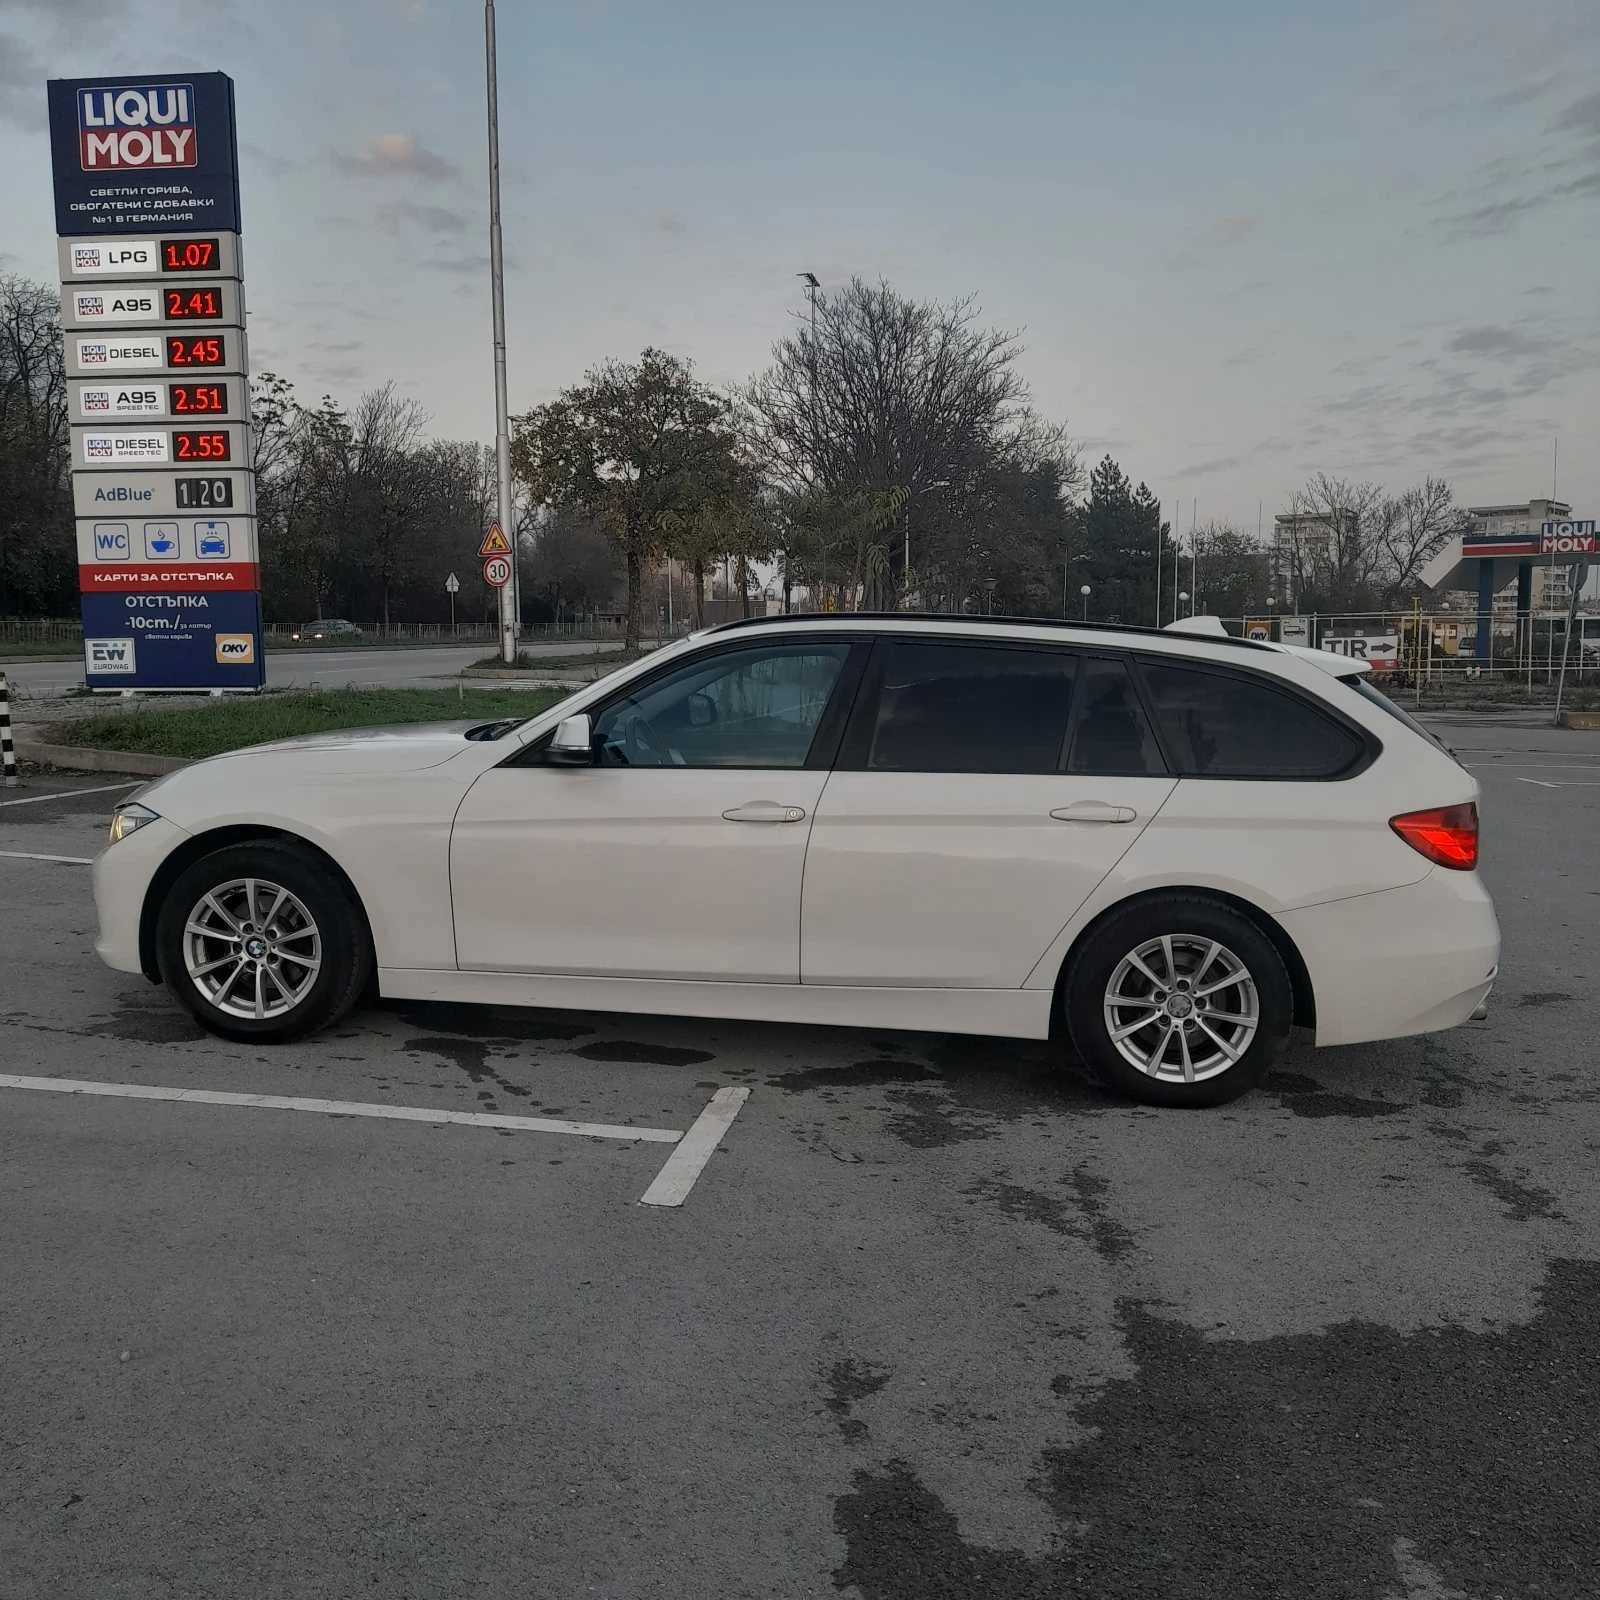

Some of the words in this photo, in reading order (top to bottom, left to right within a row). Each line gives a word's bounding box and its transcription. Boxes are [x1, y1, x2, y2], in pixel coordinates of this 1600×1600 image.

[84, 89, 189, 127] LIQUI
[86, 129, 193, 166] MOLY
[90, 187, 138, 197] СВЕТЛИ
[140, 185, 193, 195] ГОРИВА,
[70, 200, 141, 211] ОБОГАТЕНИ
[143, 200, 152, 209] С
[153, 198, 214, 209] ДОБАВКИ
[115, 214, 124, 223] В
[126, 213, 193, 223] ГЕРМАНИЯ
[109, 251, 148, 264] LPG
[167, 243, 213, 267] 1.07
[76, 258, 100, 267] MOLY
[112, 299, 152, 312] A95
[169, 292, 217, 315] 2.41
[79, 306, 104, 315] MOLY
[109, 347, 160, 359] DIESEL
[172, 340, 219, 363] 2.45
[82, 354, 107, 363] MOLY
[116, 391, 157, 404] A95
[175, 388, 222, 410] 2.51
[85, 401, 109, 410] MOLY
[115, 439, 165, 449] DIESEL
[178, 435, 225, 457] 2.55
[88, 448, 112, 457] MOLY
[180, 480, 227, 506] 1.20
[1543, 521, 1592, 537] LIQUI
[97, 534, 126, 549] WC
[1543, 537, 1593, 552] MOLY
[94, 573, 138, 582] КАРТИ
[140, 573, 158, 582] ЗА
[161, 572, 234, 581] ОТСТЪПКА
[489, 563, 506, 578] 30
[125, 595, 209, 608] ОТСТЪПКА
[221, 643, 248, 653] DKV
[1325, 639, 1368, 658] TIR
[93, 649, 126, 661] EW
